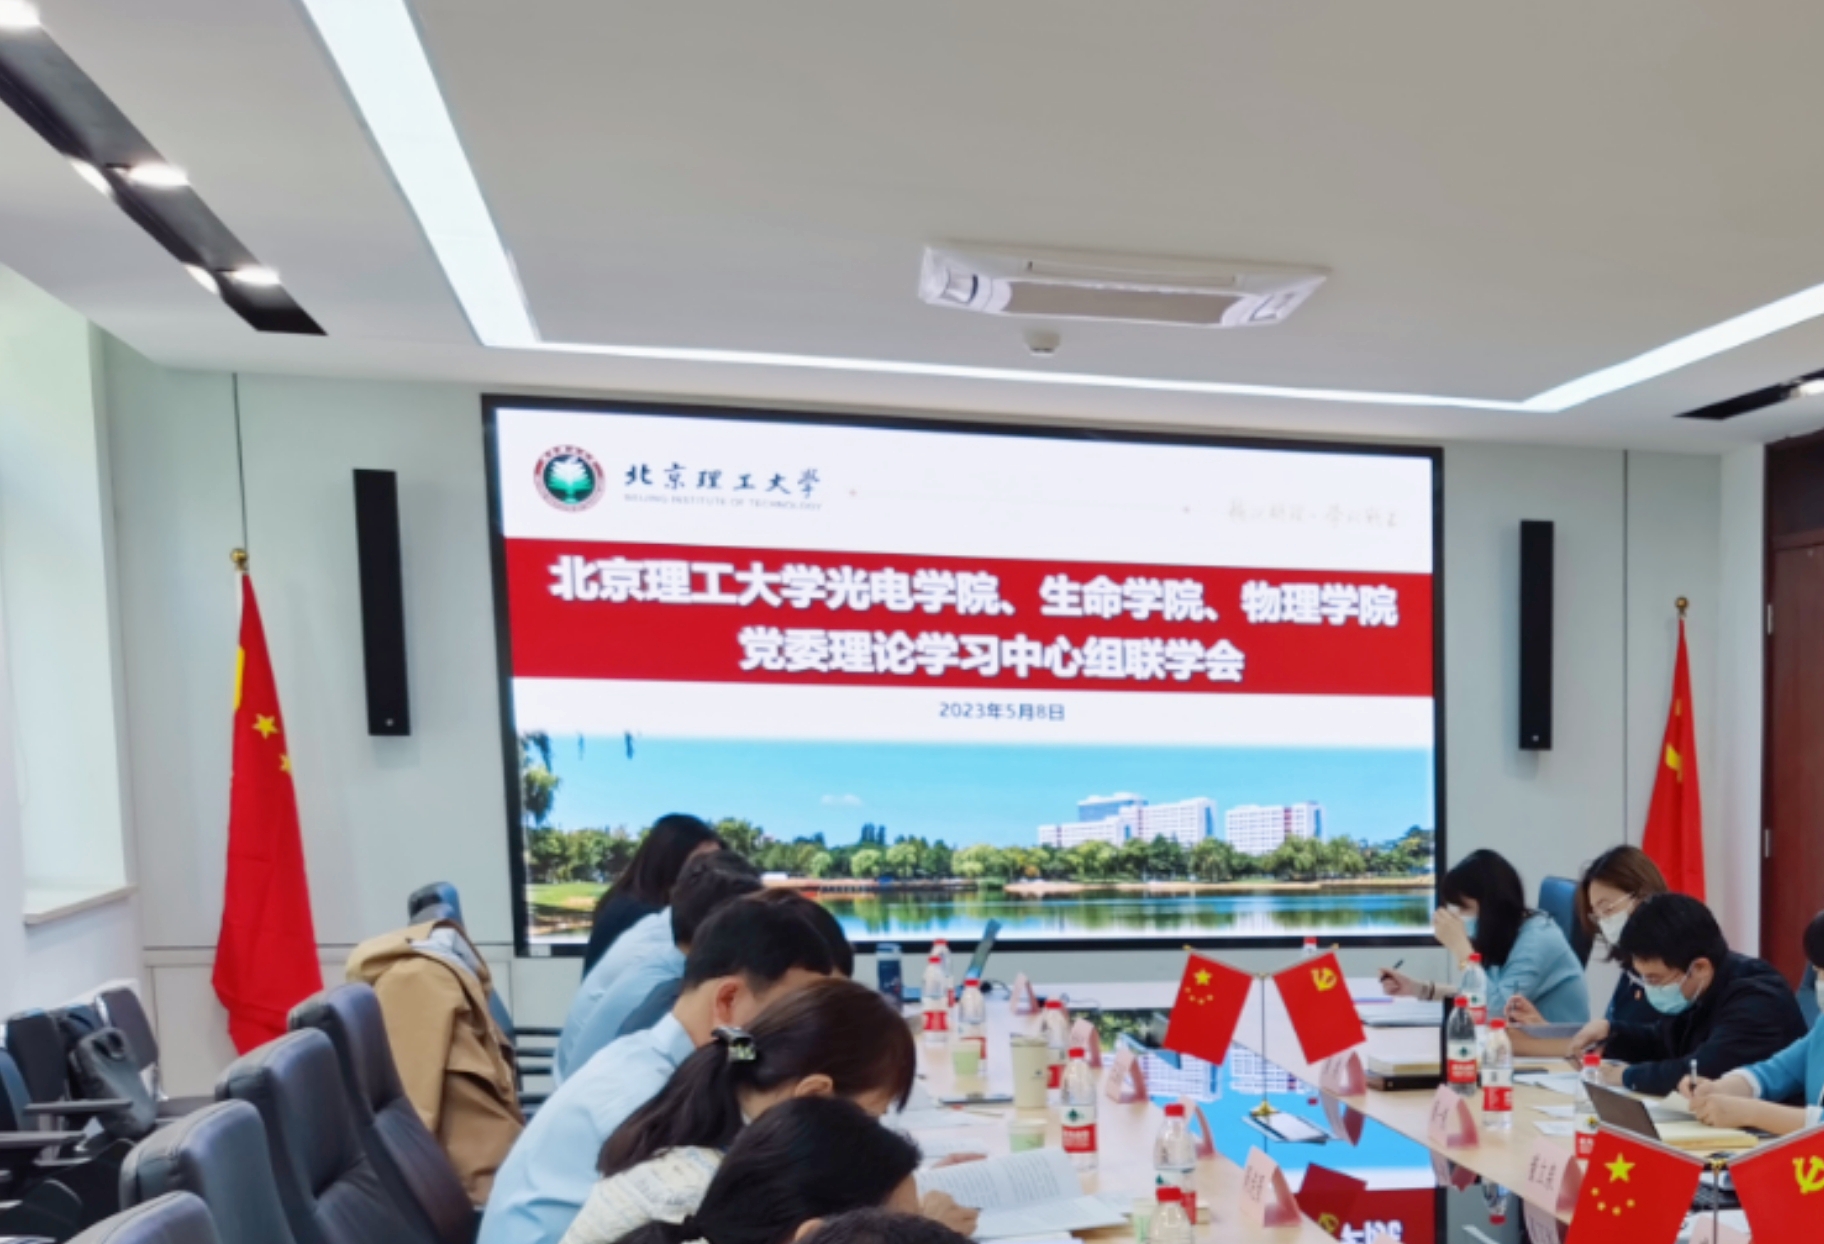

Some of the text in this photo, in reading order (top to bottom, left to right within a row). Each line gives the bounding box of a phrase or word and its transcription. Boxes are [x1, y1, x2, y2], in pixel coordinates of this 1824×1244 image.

[548, 555, 1400, 627] 北京理工大学光电学院、生命学院、物理学院
[738, 626, 1245, 684] 党委理论学习中心组联学会
[938, 700, 1066, 722] 2023年5月8日
